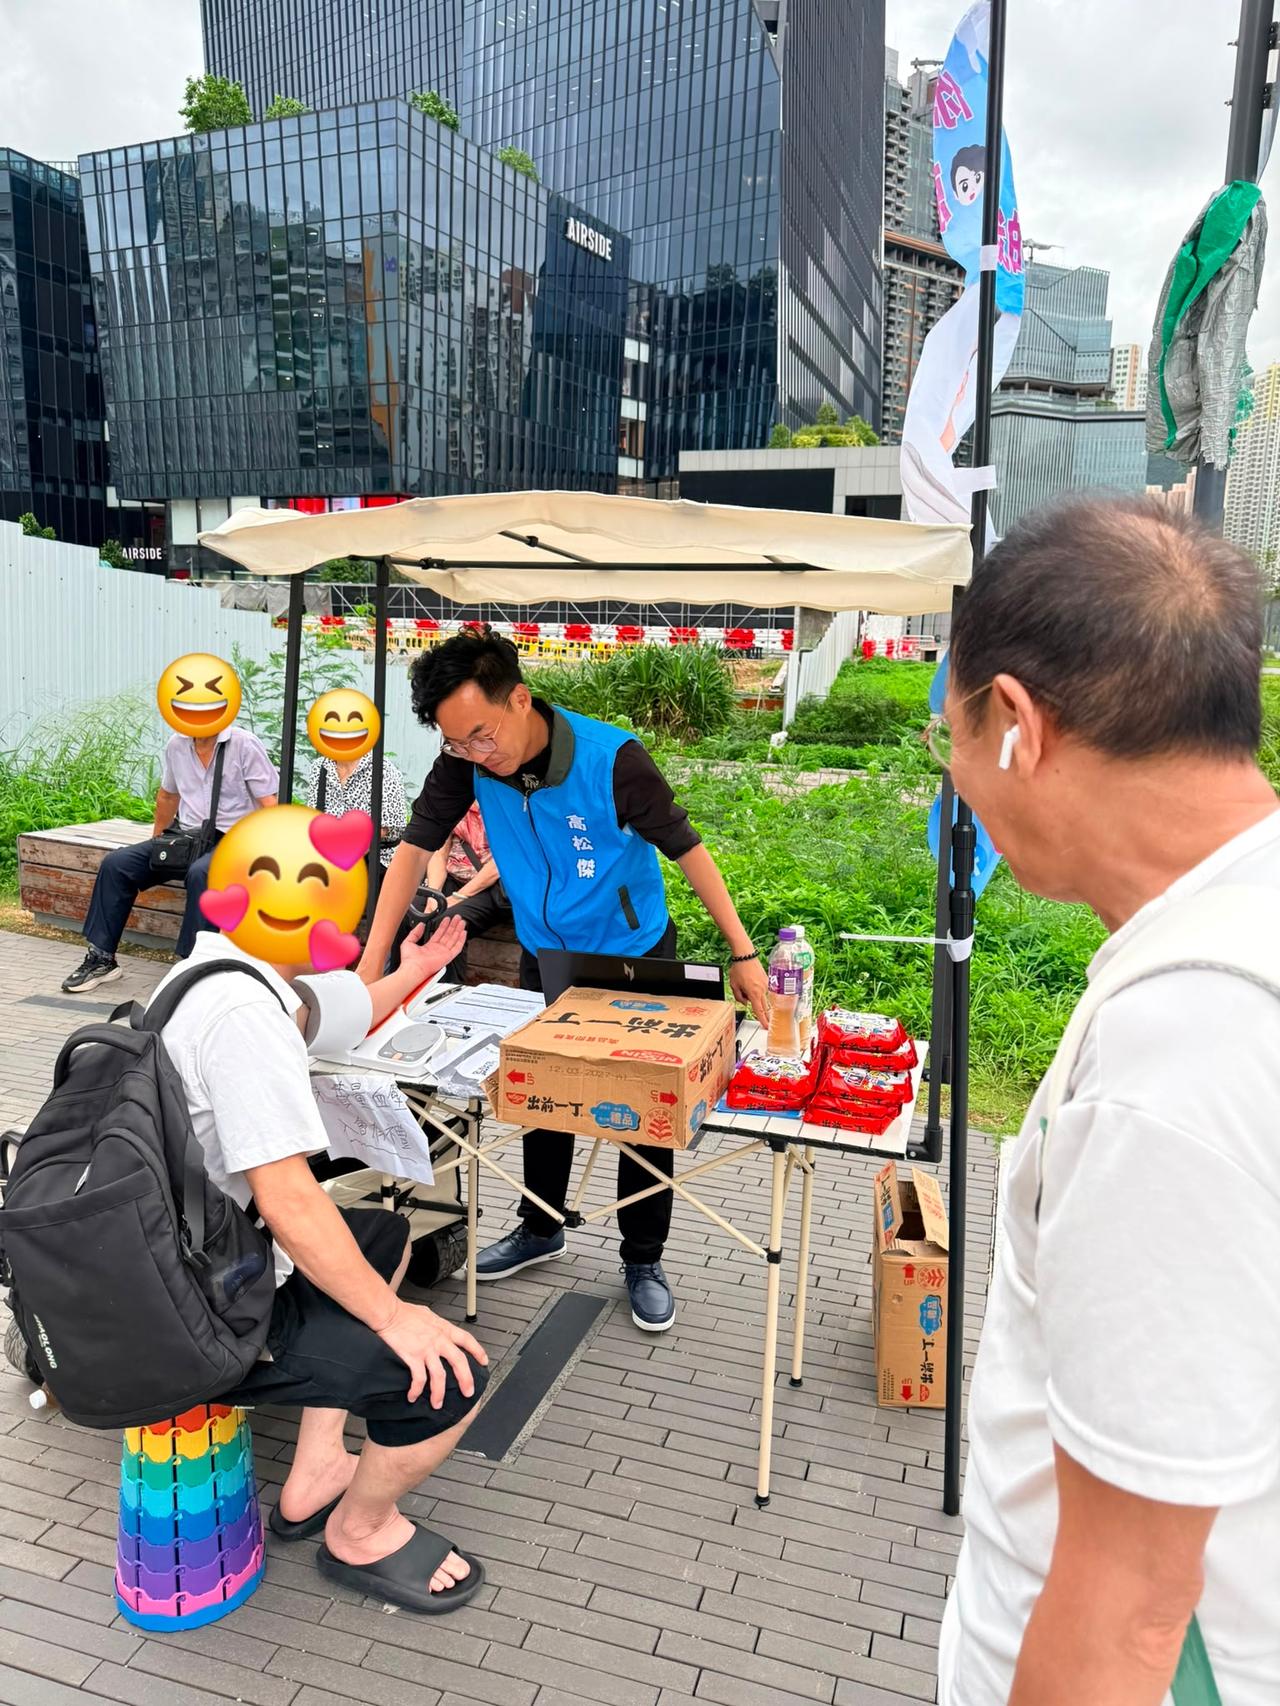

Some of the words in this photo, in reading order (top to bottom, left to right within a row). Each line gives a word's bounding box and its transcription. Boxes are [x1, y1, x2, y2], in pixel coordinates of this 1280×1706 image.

[565, 216, 612, 261] AIRSIDE
[122, 547, 162, 560] AIRSIDE
[565, 814, 596, 878] 高松傑
[541, 1012, 702, 1039] 出前一丁
[619, 1050, 679, 1063] NISSIN
[526, 1072, 535, 1085] UP
[527, 1095, 584, 1117] 出前一丁
[650, 1089, 660, 1103] UP
[920, 1338, 935, 1385] 出前一丁
